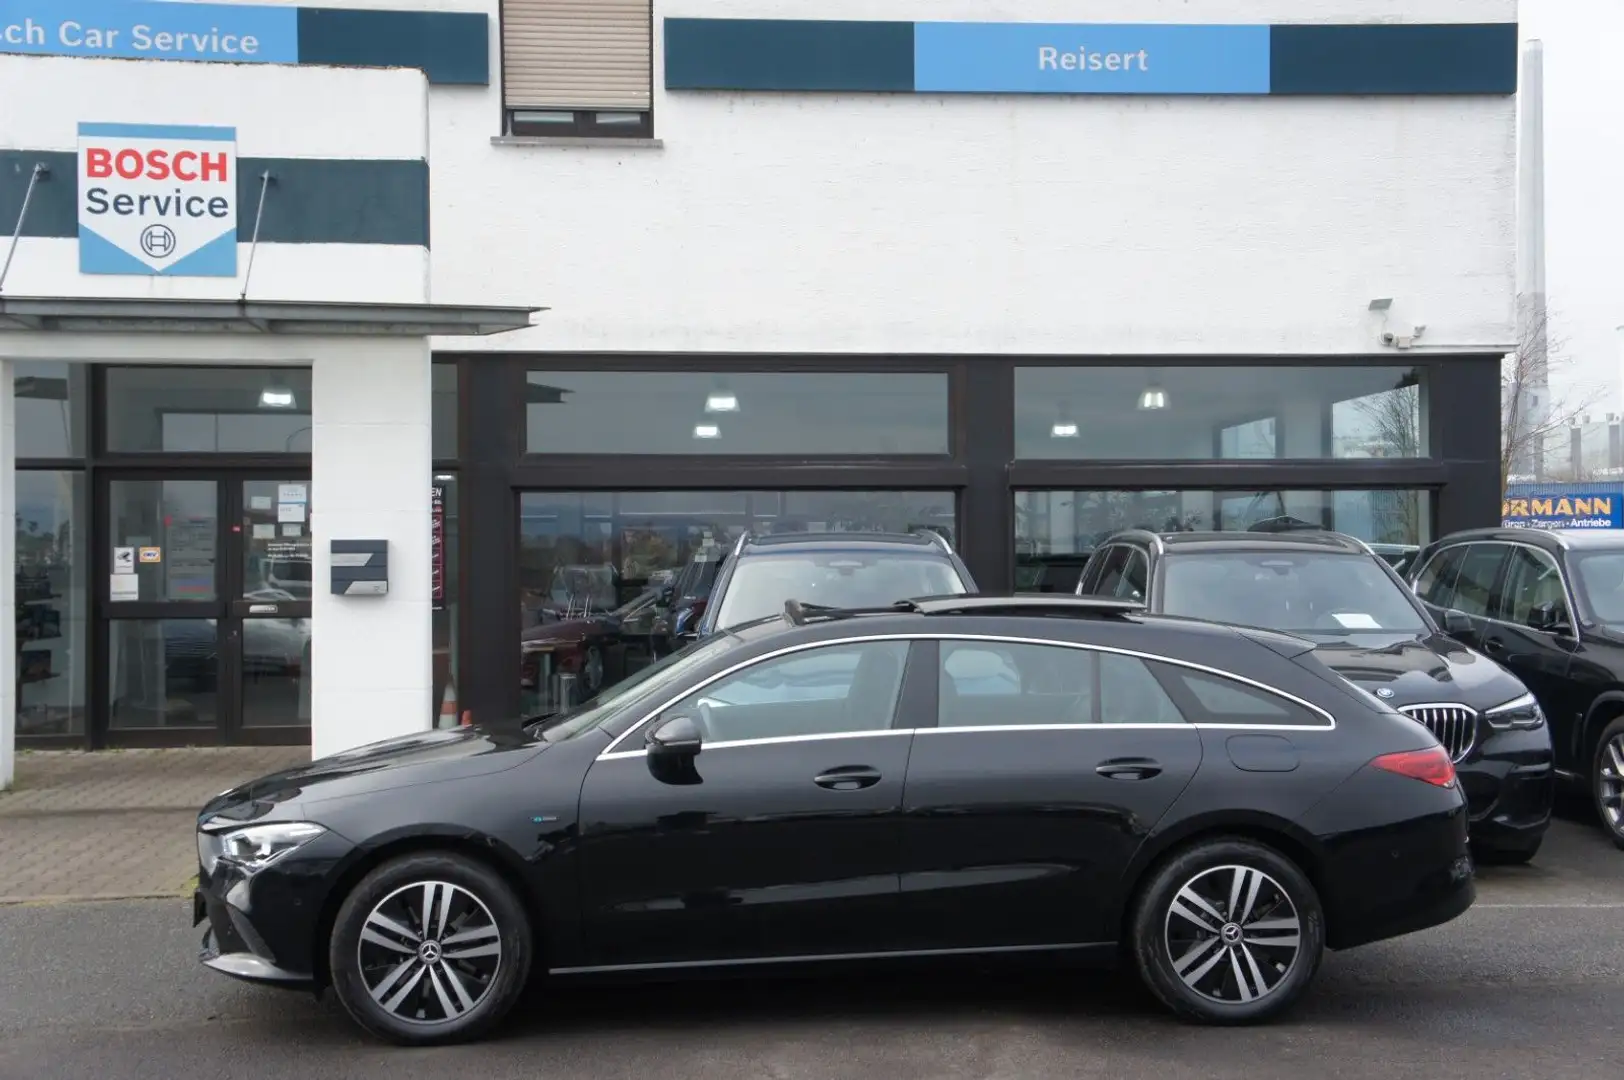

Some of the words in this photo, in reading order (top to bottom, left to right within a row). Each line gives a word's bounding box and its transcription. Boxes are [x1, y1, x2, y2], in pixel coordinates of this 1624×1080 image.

[0, 18, 45, 46] ch
[58, 20, 119, 48] Car
[132, 24, 259, 54] Service
[1038, 45, 1149, 71] Reisert
[86, 148, 227, 182] BOSCH
[86, 187, 229, 218] Service
